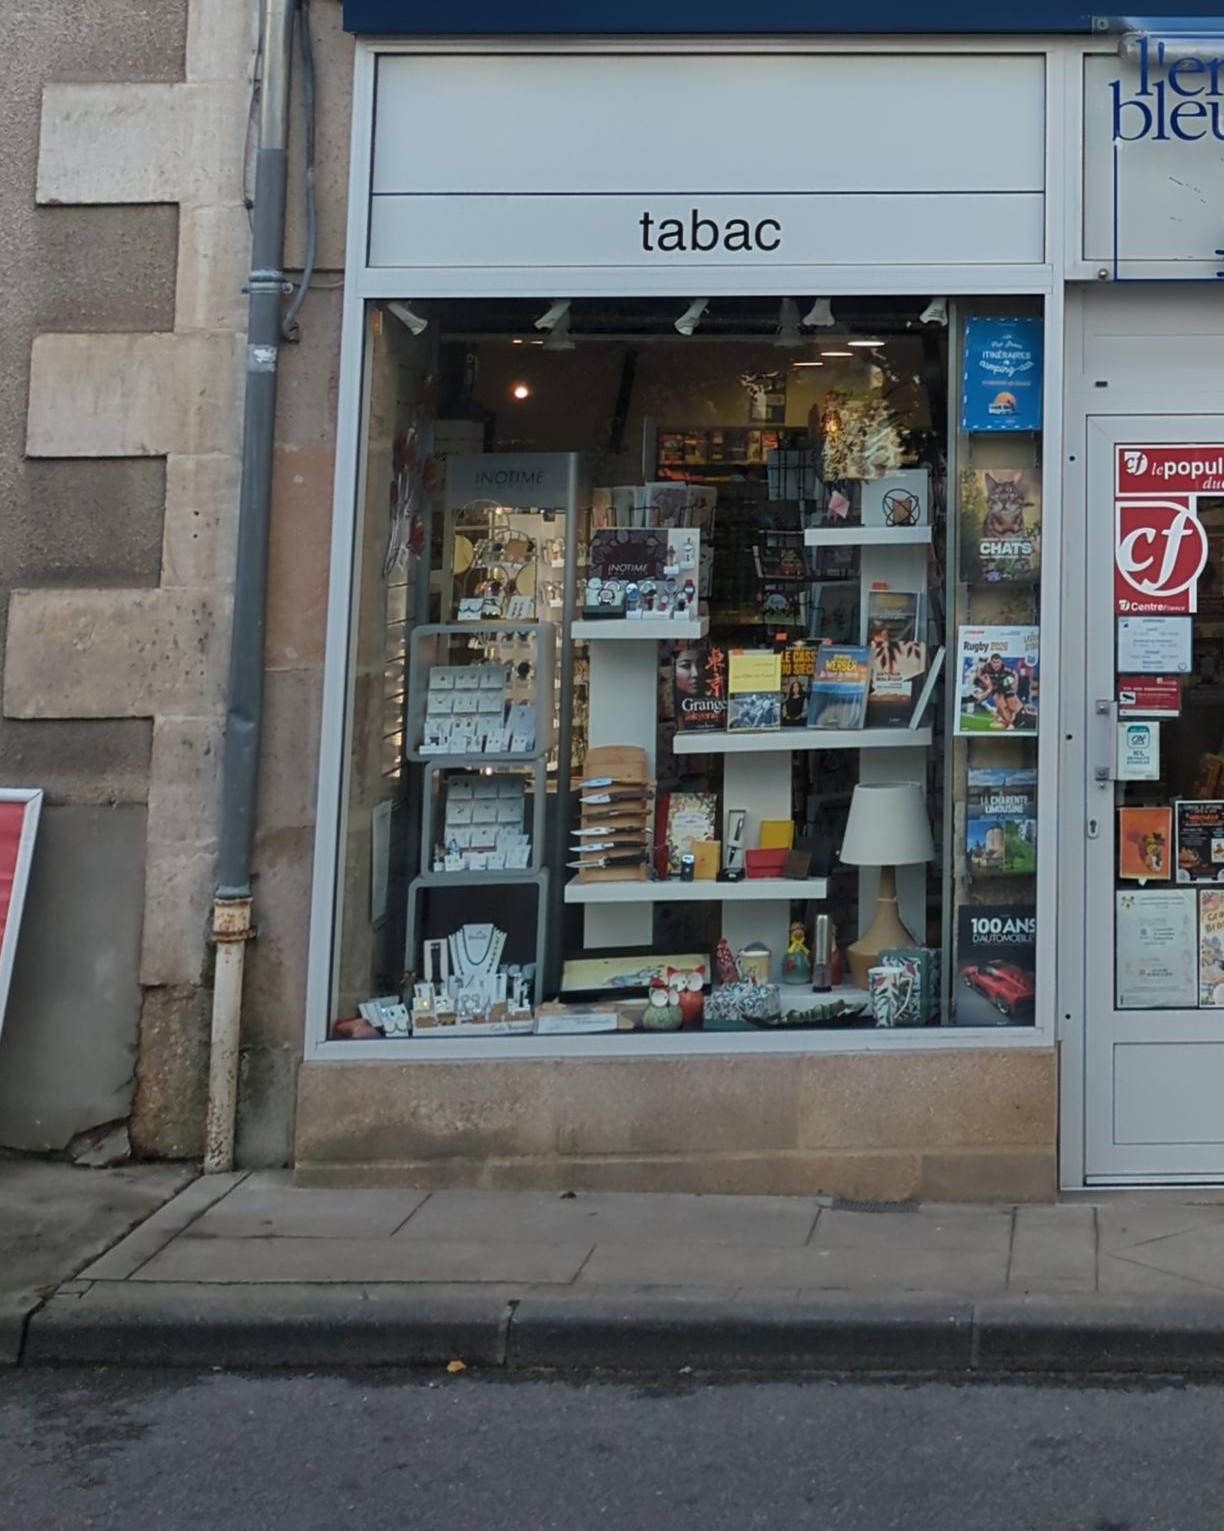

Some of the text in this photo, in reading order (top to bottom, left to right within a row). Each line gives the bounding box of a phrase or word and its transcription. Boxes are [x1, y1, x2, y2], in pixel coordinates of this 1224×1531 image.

[639, 209, 783, 253] tabac
[475, 470, 545, 485] INOTIME
[980, 542, 1033, 554] CHATS
[964, 640, 989, 653] Rugby
[971, 918, 1036, 934] 100 ANS
